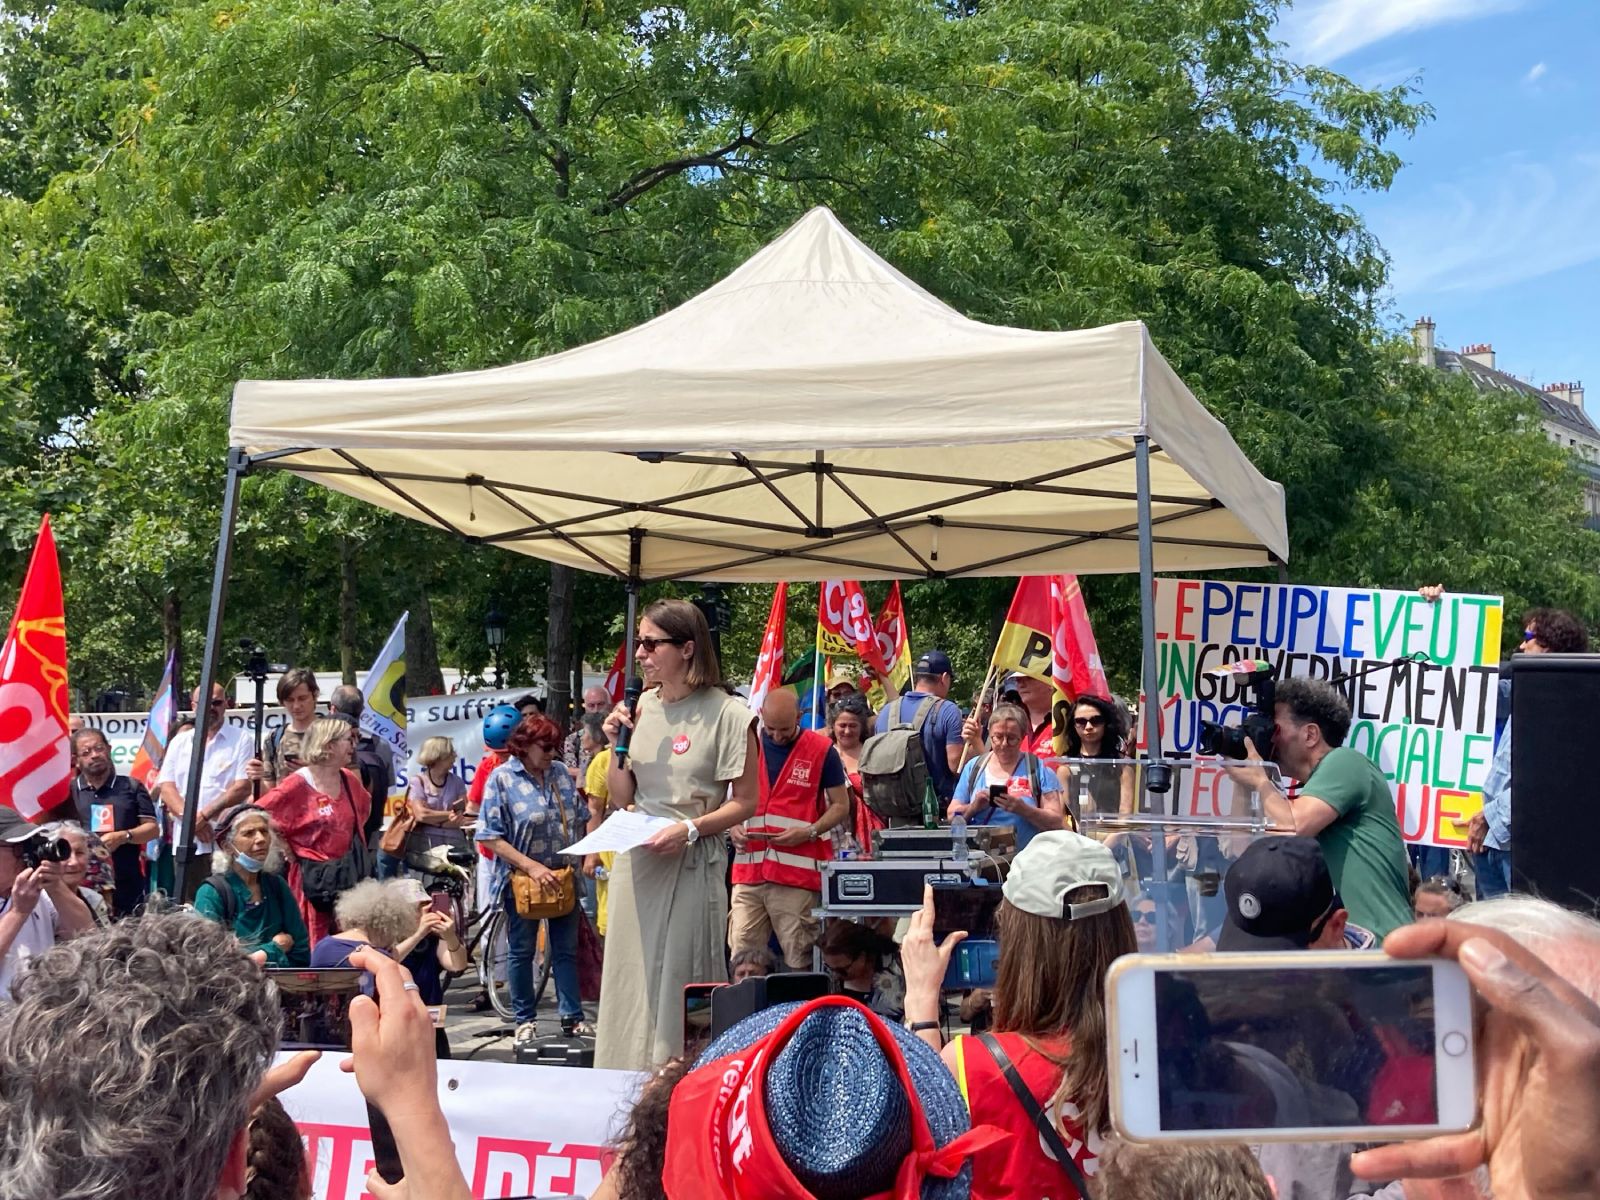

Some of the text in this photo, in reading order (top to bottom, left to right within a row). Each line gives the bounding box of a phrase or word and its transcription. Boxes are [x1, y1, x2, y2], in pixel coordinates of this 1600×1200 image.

[1201, 582, 1370, 658] PEUPLE
[1373, 592, 1501, 667] VEUT
[1349, 717, 1493, 793] OCIALE
